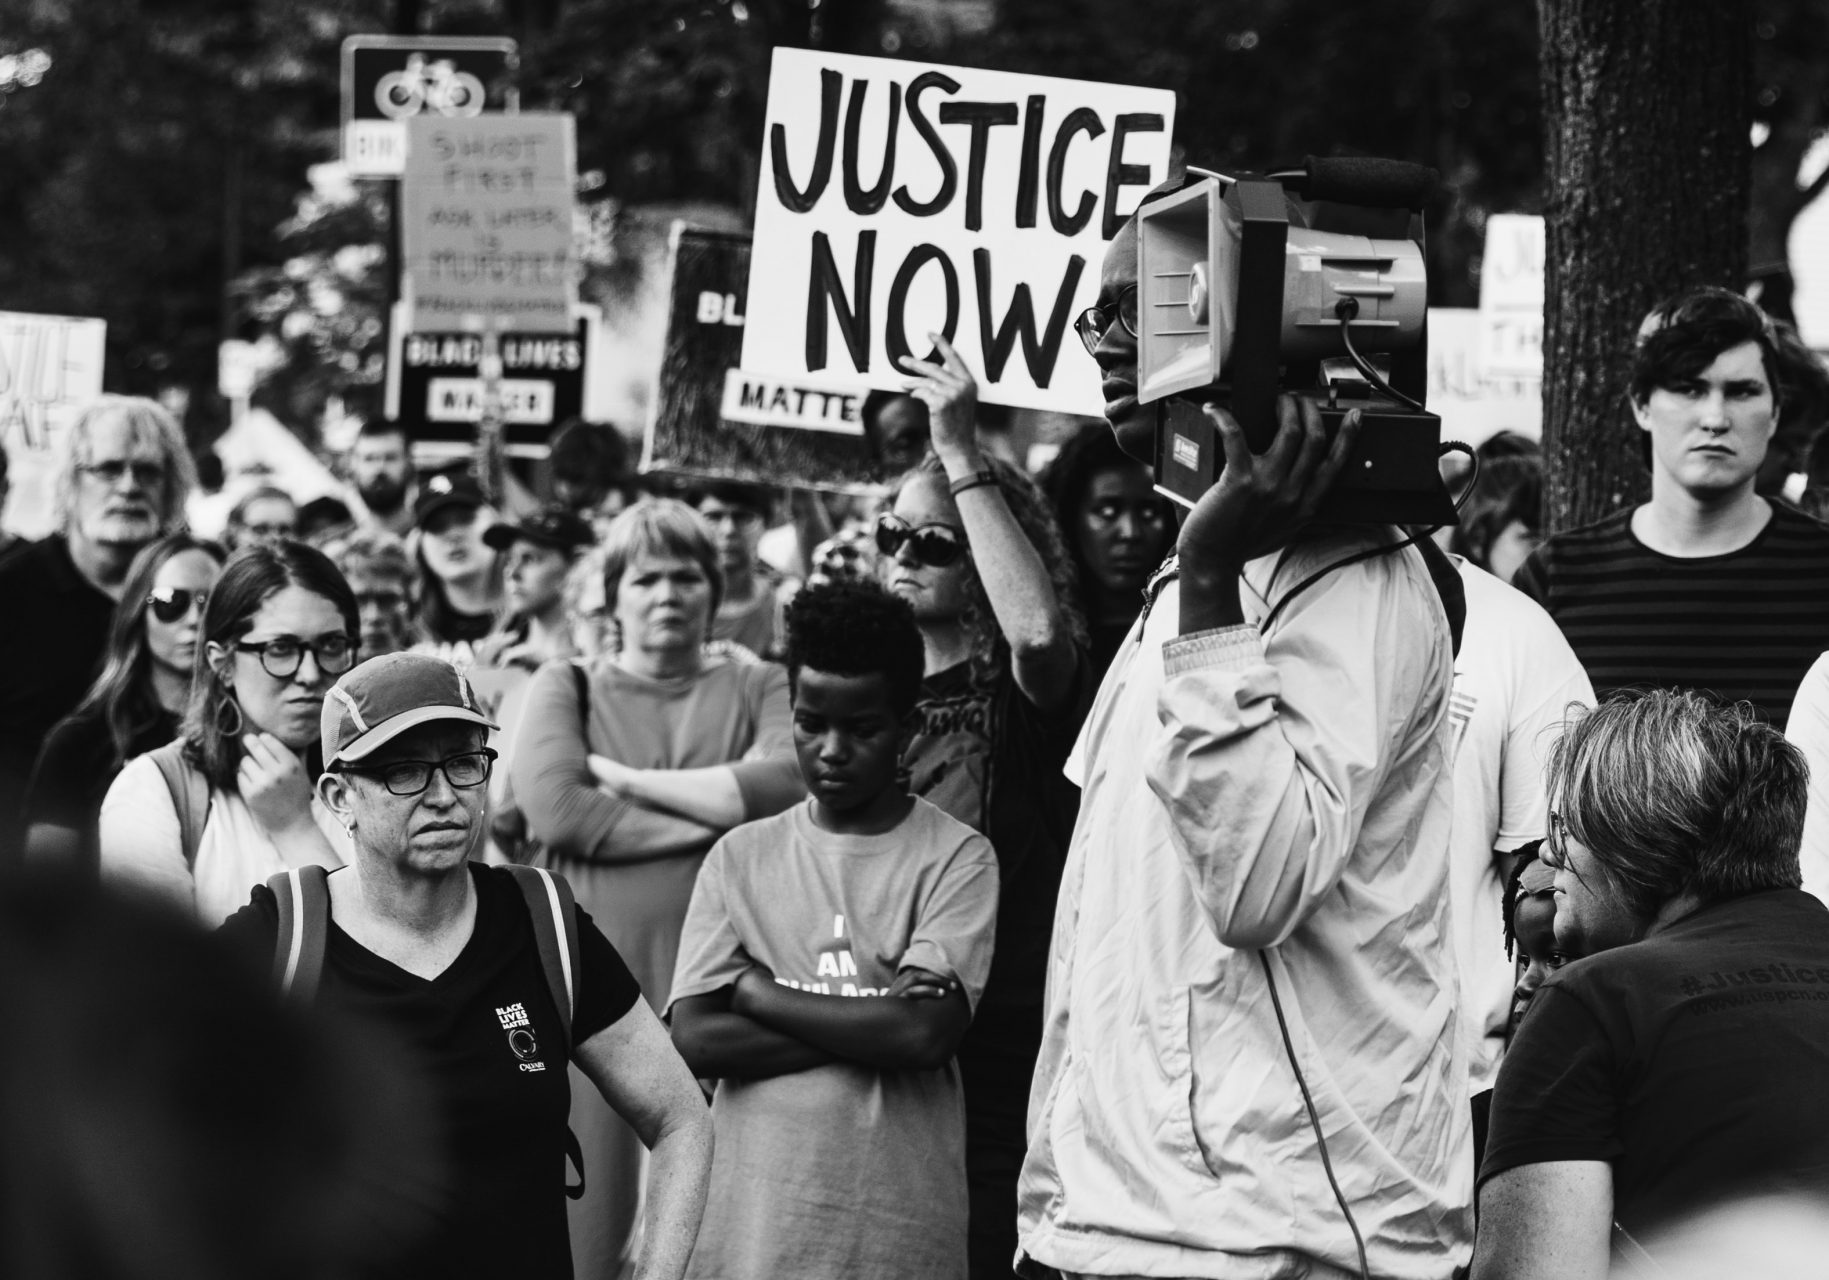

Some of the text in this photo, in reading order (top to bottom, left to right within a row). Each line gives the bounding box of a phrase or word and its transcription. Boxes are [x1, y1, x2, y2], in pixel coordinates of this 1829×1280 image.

[770, 67, 1165, 241] JUSTICE
[804, 230, 1086, 390] NOW
[407, 336, 581, 370] BLAC LIVES
[740, 381, 859, 422] MATTE
[834, 914, 845, 938] I
[495, 1002, 524, 1016] BLACK
[498, 1010, 528, 1024] LIVES
[1689, 989, 1829, 1017] www.uspcn.o
[502, 1018, 531, 1030] MATTER
